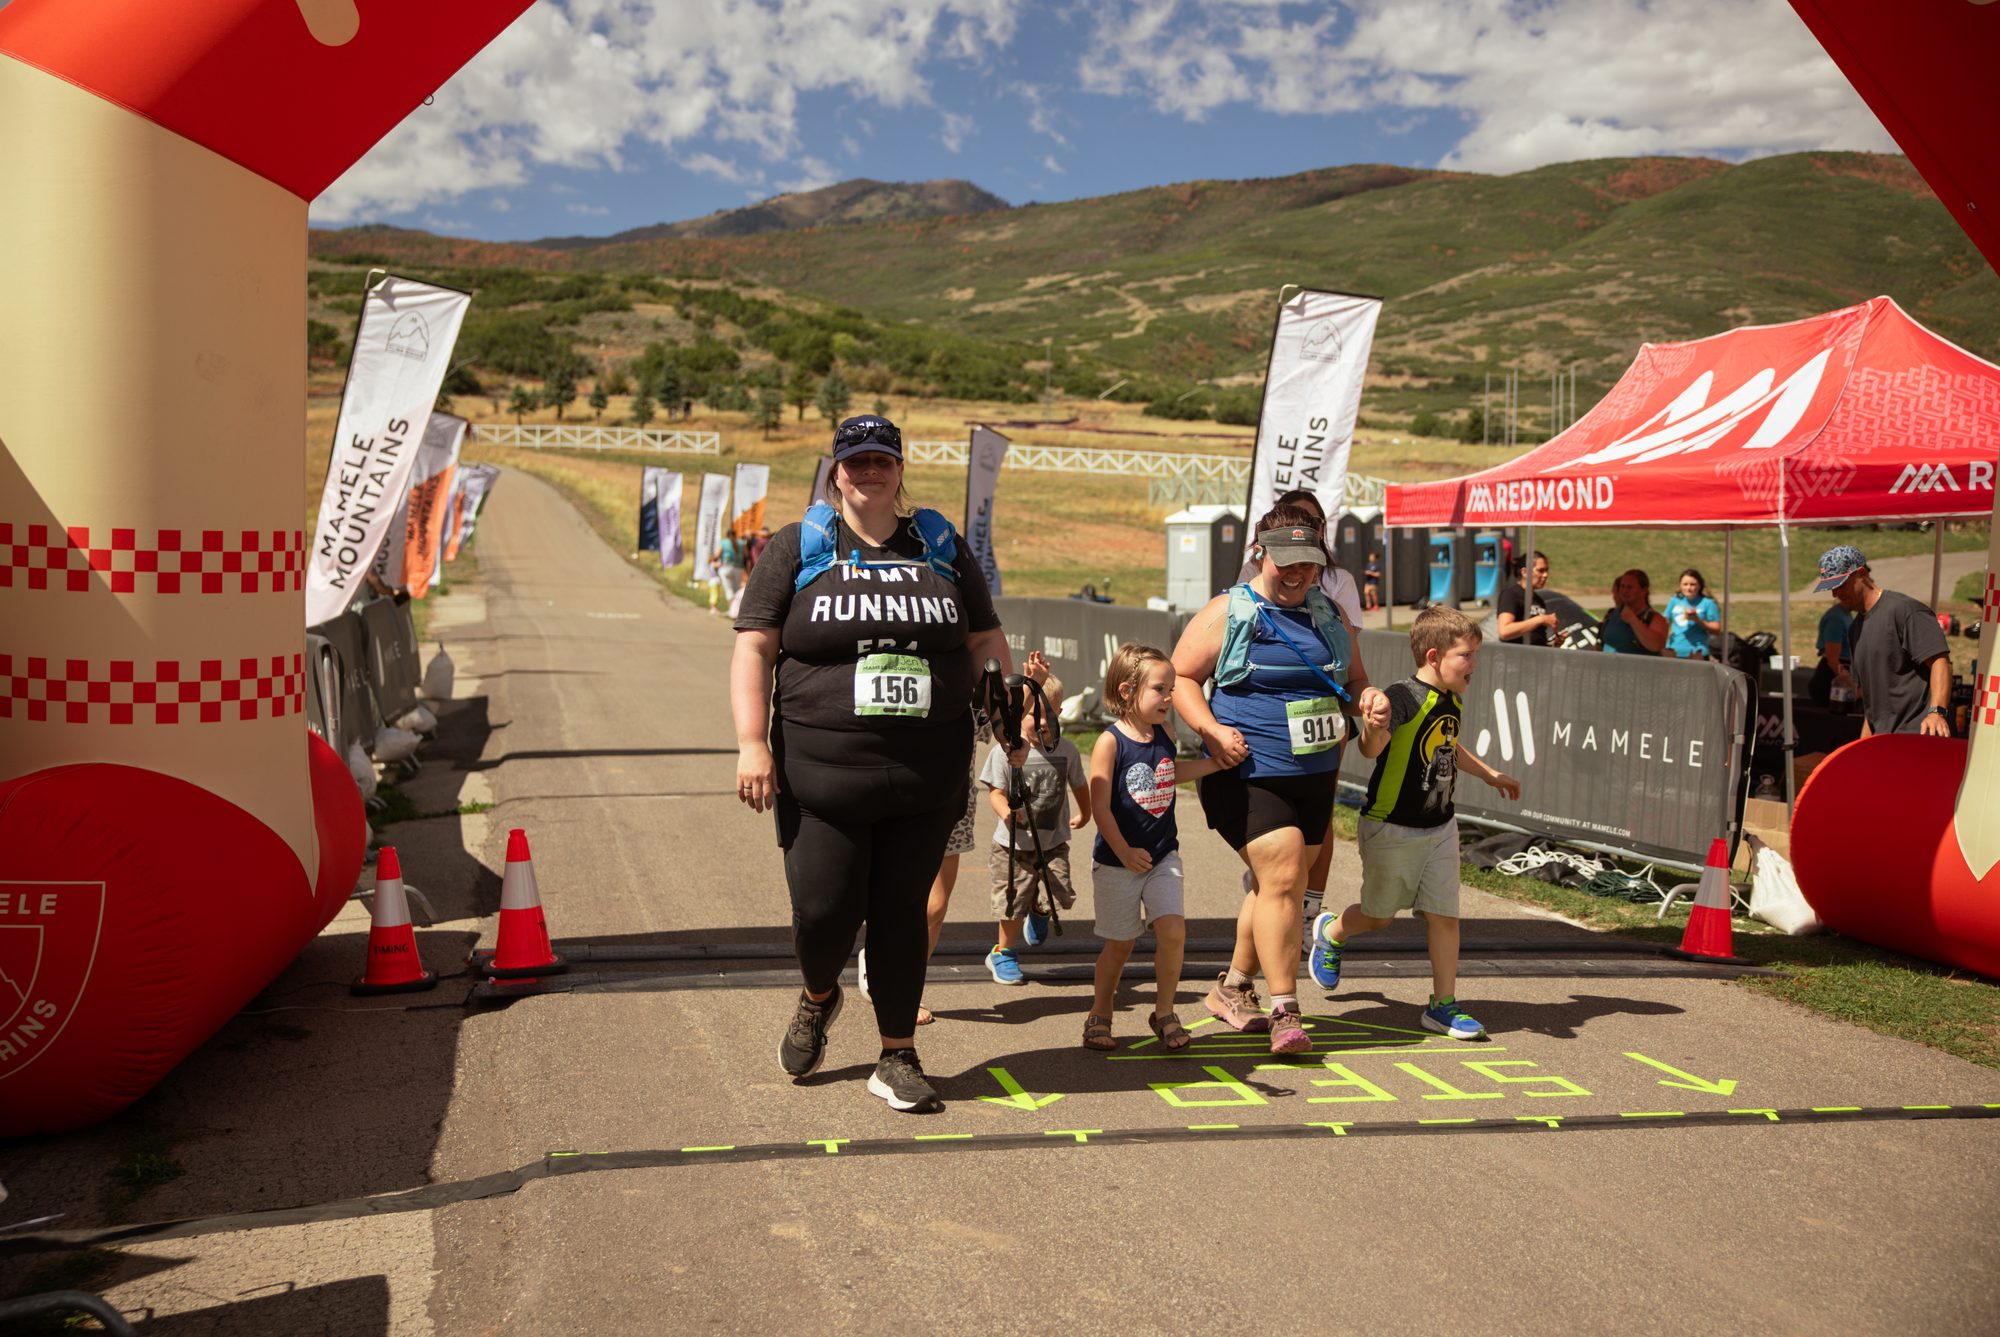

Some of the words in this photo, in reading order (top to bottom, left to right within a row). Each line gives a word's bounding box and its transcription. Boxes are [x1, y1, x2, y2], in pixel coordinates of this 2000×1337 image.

[320, 433, 374, 557] MAMELE
[330, 418, 409, 589] MOUNTAINS
[1496, 476, 1614, 512] REDMOND
[842, 565, 871, 582] IN
[878, 567, 920, 582] MY
[811, 594, 959, 624] RUNNING
[871, 675, 918, 705] 156
[1302, 716, 1337, 744] 911
[1553, 720, 1704, 767] MAMELE
[1520, 809, 1532, 817] JOIN
[1532, 810, 1543, 819] OUR
[1543, 813, 1581, 827] COMMUNITY
[1582, 821, 1591, 829] AT
[1592, 823, 1631, 837] MAMELE.COM
[374, 944, 409, 956] TIMING
[1148, 1060, 1594, 1108] STEP
